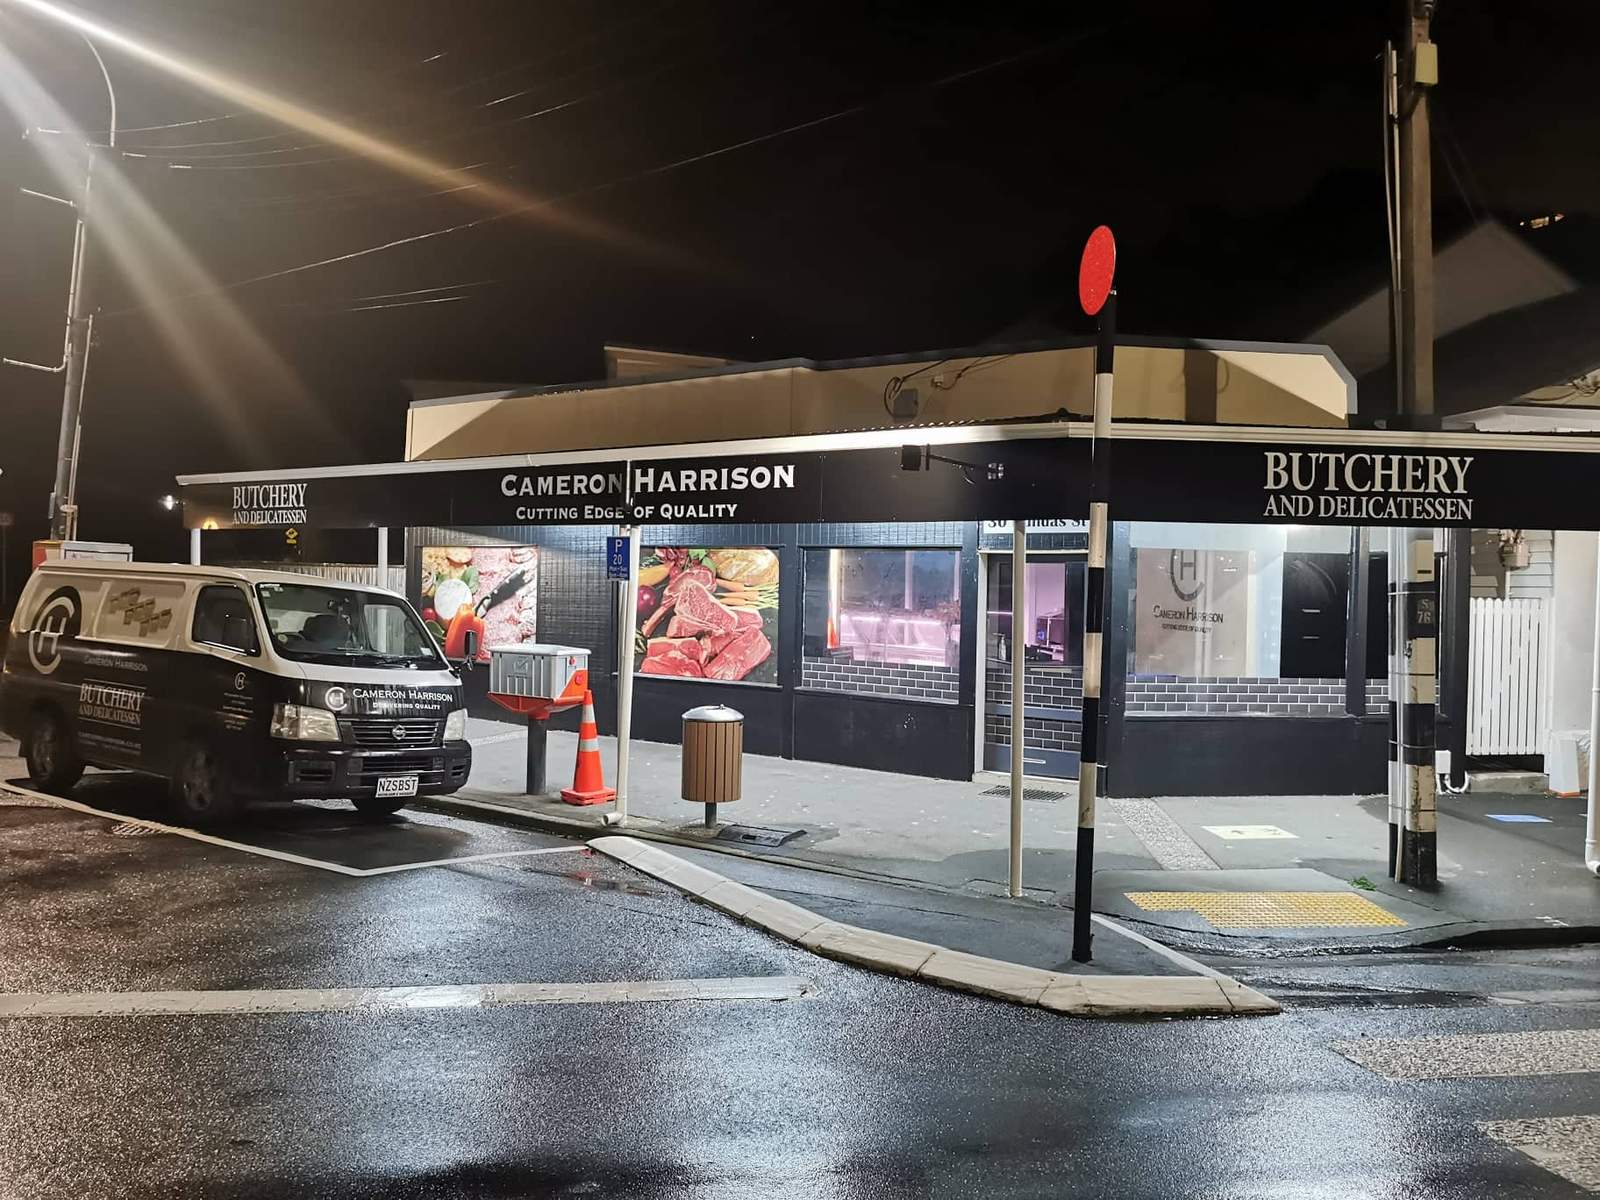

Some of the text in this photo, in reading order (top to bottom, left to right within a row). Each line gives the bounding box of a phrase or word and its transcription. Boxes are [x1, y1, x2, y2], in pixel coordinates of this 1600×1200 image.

[1264, 452, 1474, 493] BUTCHERY
[501, 465, 795, 496] CAMERON HARRISON
[233, 484, 307, 509] BUTCHERY
[516, 503, 738, 519] CUTTING EDGE OF QUALITY
[1264, 495, 1474, 520] AND DELICATESSEN
[232, 509, 307, 524] AND DELICATESSEN
[615, 539, 623, 553] P
[612, 554, 623, 565] 20
[1153, 605, 1186, 620] CAMERON
[1416, 610, 1432, 624] 76
[80, 683, 144, 711] BUTCHERY
[352, 688, 453, 702] CAMERON HARRISON
[378, 779, 417, 791] NZSBST
